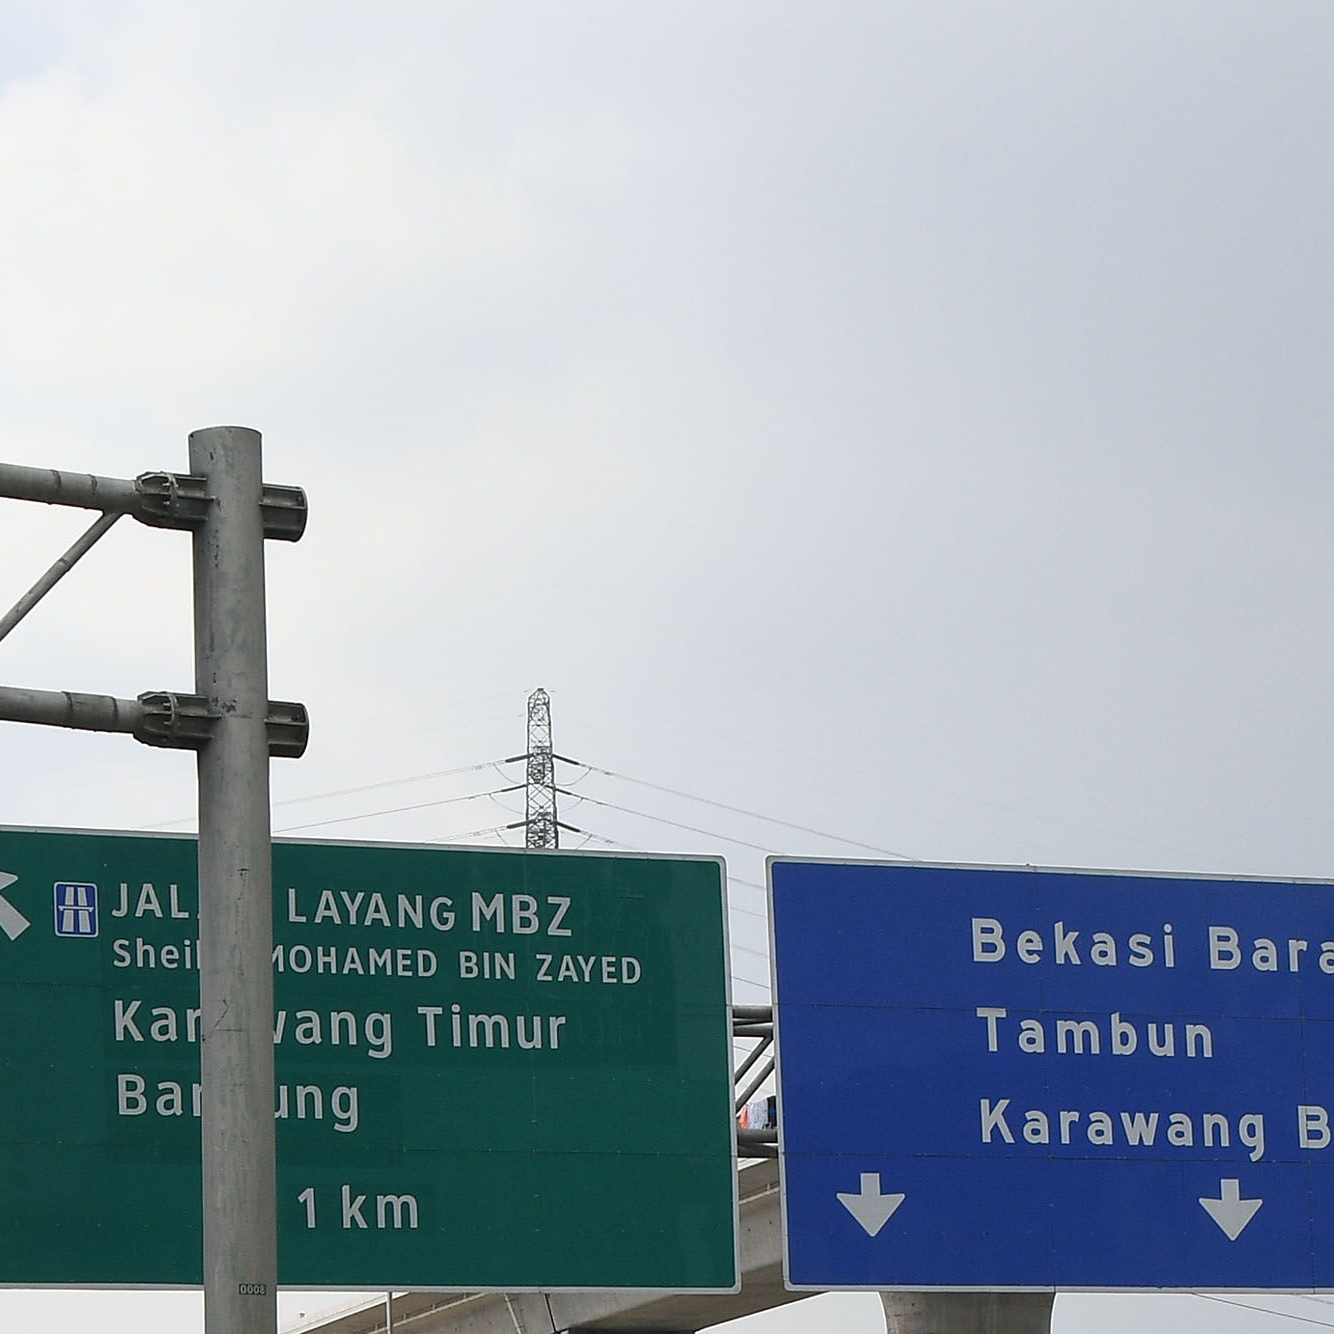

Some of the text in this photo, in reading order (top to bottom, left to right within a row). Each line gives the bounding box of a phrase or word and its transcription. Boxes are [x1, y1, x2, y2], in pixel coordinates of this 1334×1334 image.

[288, 888, 456, 931] LAYANG
[471, 891, 572, 937] MBZ
[459, 950, 515, 980] BIN
[535, 953, 641, 984] ZAYED
[971, 917, 1175, 968] Bekasi
[417, 1006, 566, 1049] Timur
[976, 1007, 1213, 1058] Tambun
[980, 1098, 1265, 1162] Karawang
[297, 1184, 418, 1229] 1 km
